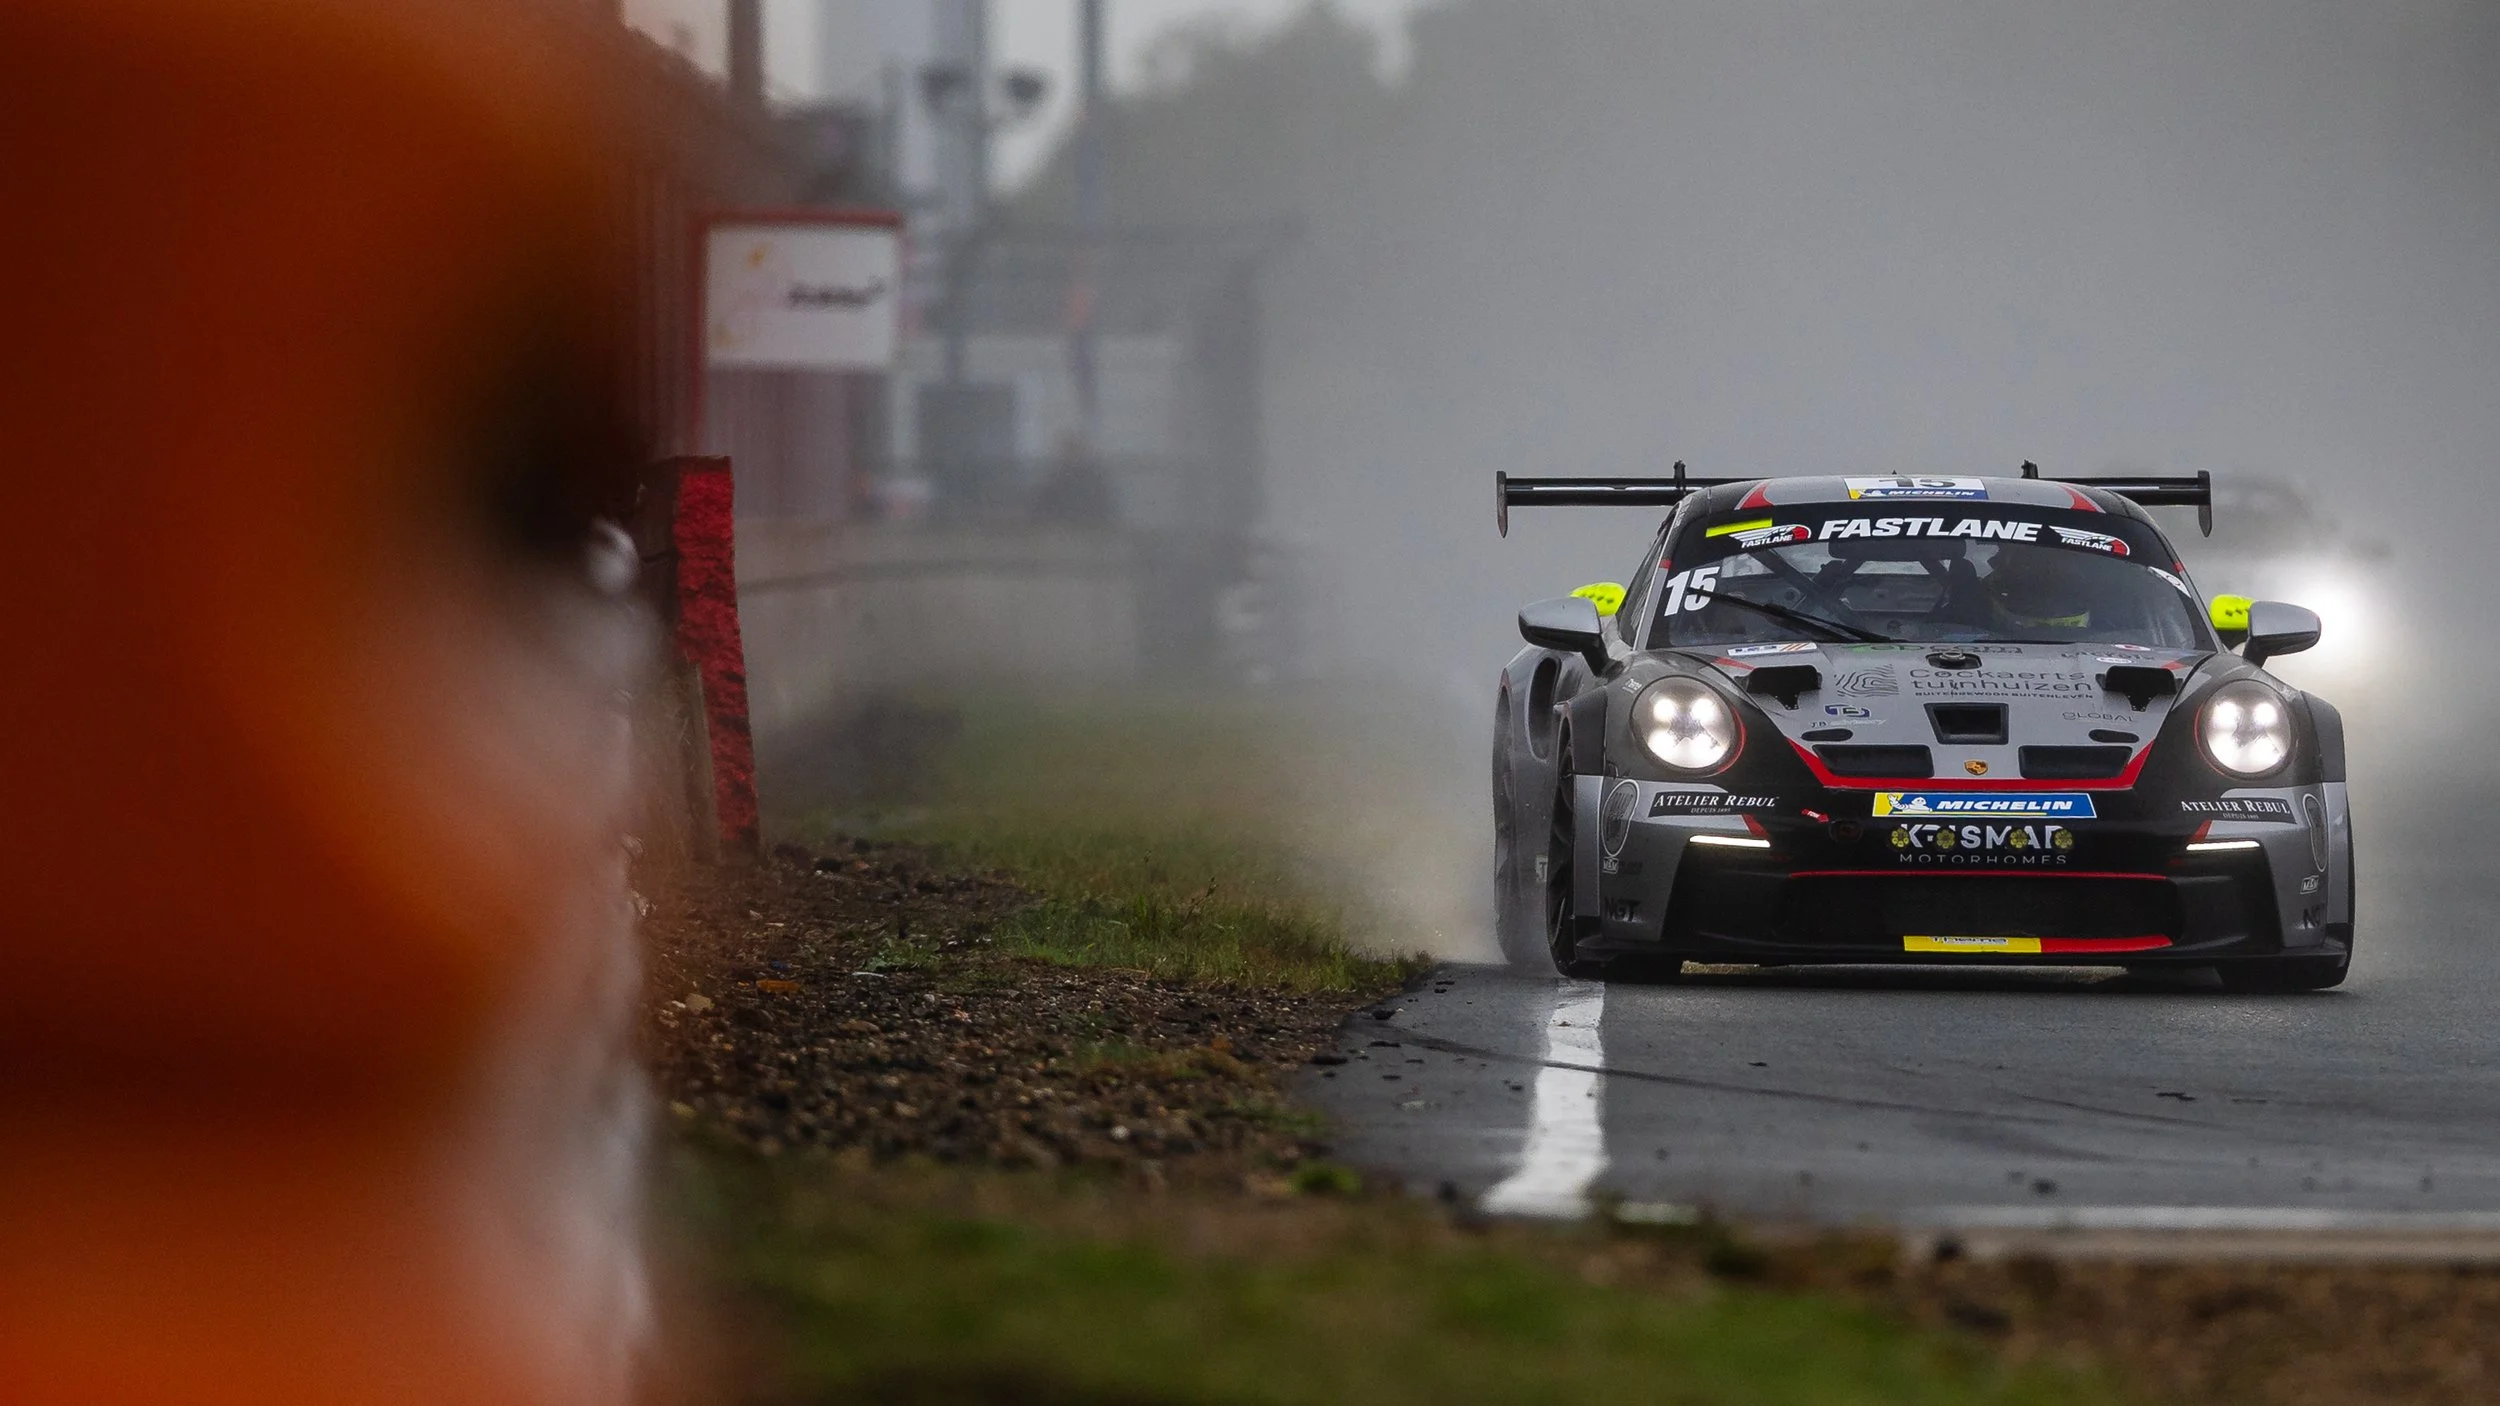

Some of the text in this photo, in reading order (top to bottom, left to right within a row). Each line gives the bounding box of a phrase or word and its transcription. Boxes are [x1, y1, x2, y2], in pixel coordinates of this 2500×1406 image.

[1818, 518, 2043, 542] FASTLANE
[1741, 534, 1794, 549] FASTLANE
[2060, 536, 2113, 552] FASTLANE
[1664, 566, 1720, 617] 15
[1909, 669, 2085, 681] Cockaerts
[1654, 794, 1777, 808] ATELIER REBUL
[1936, 800, 2073, 811] MICHELIN
[2181, 800, 2291, 815] ATELIER REBUL
[1899, 853, 2067, 865] MOTORHOMES
